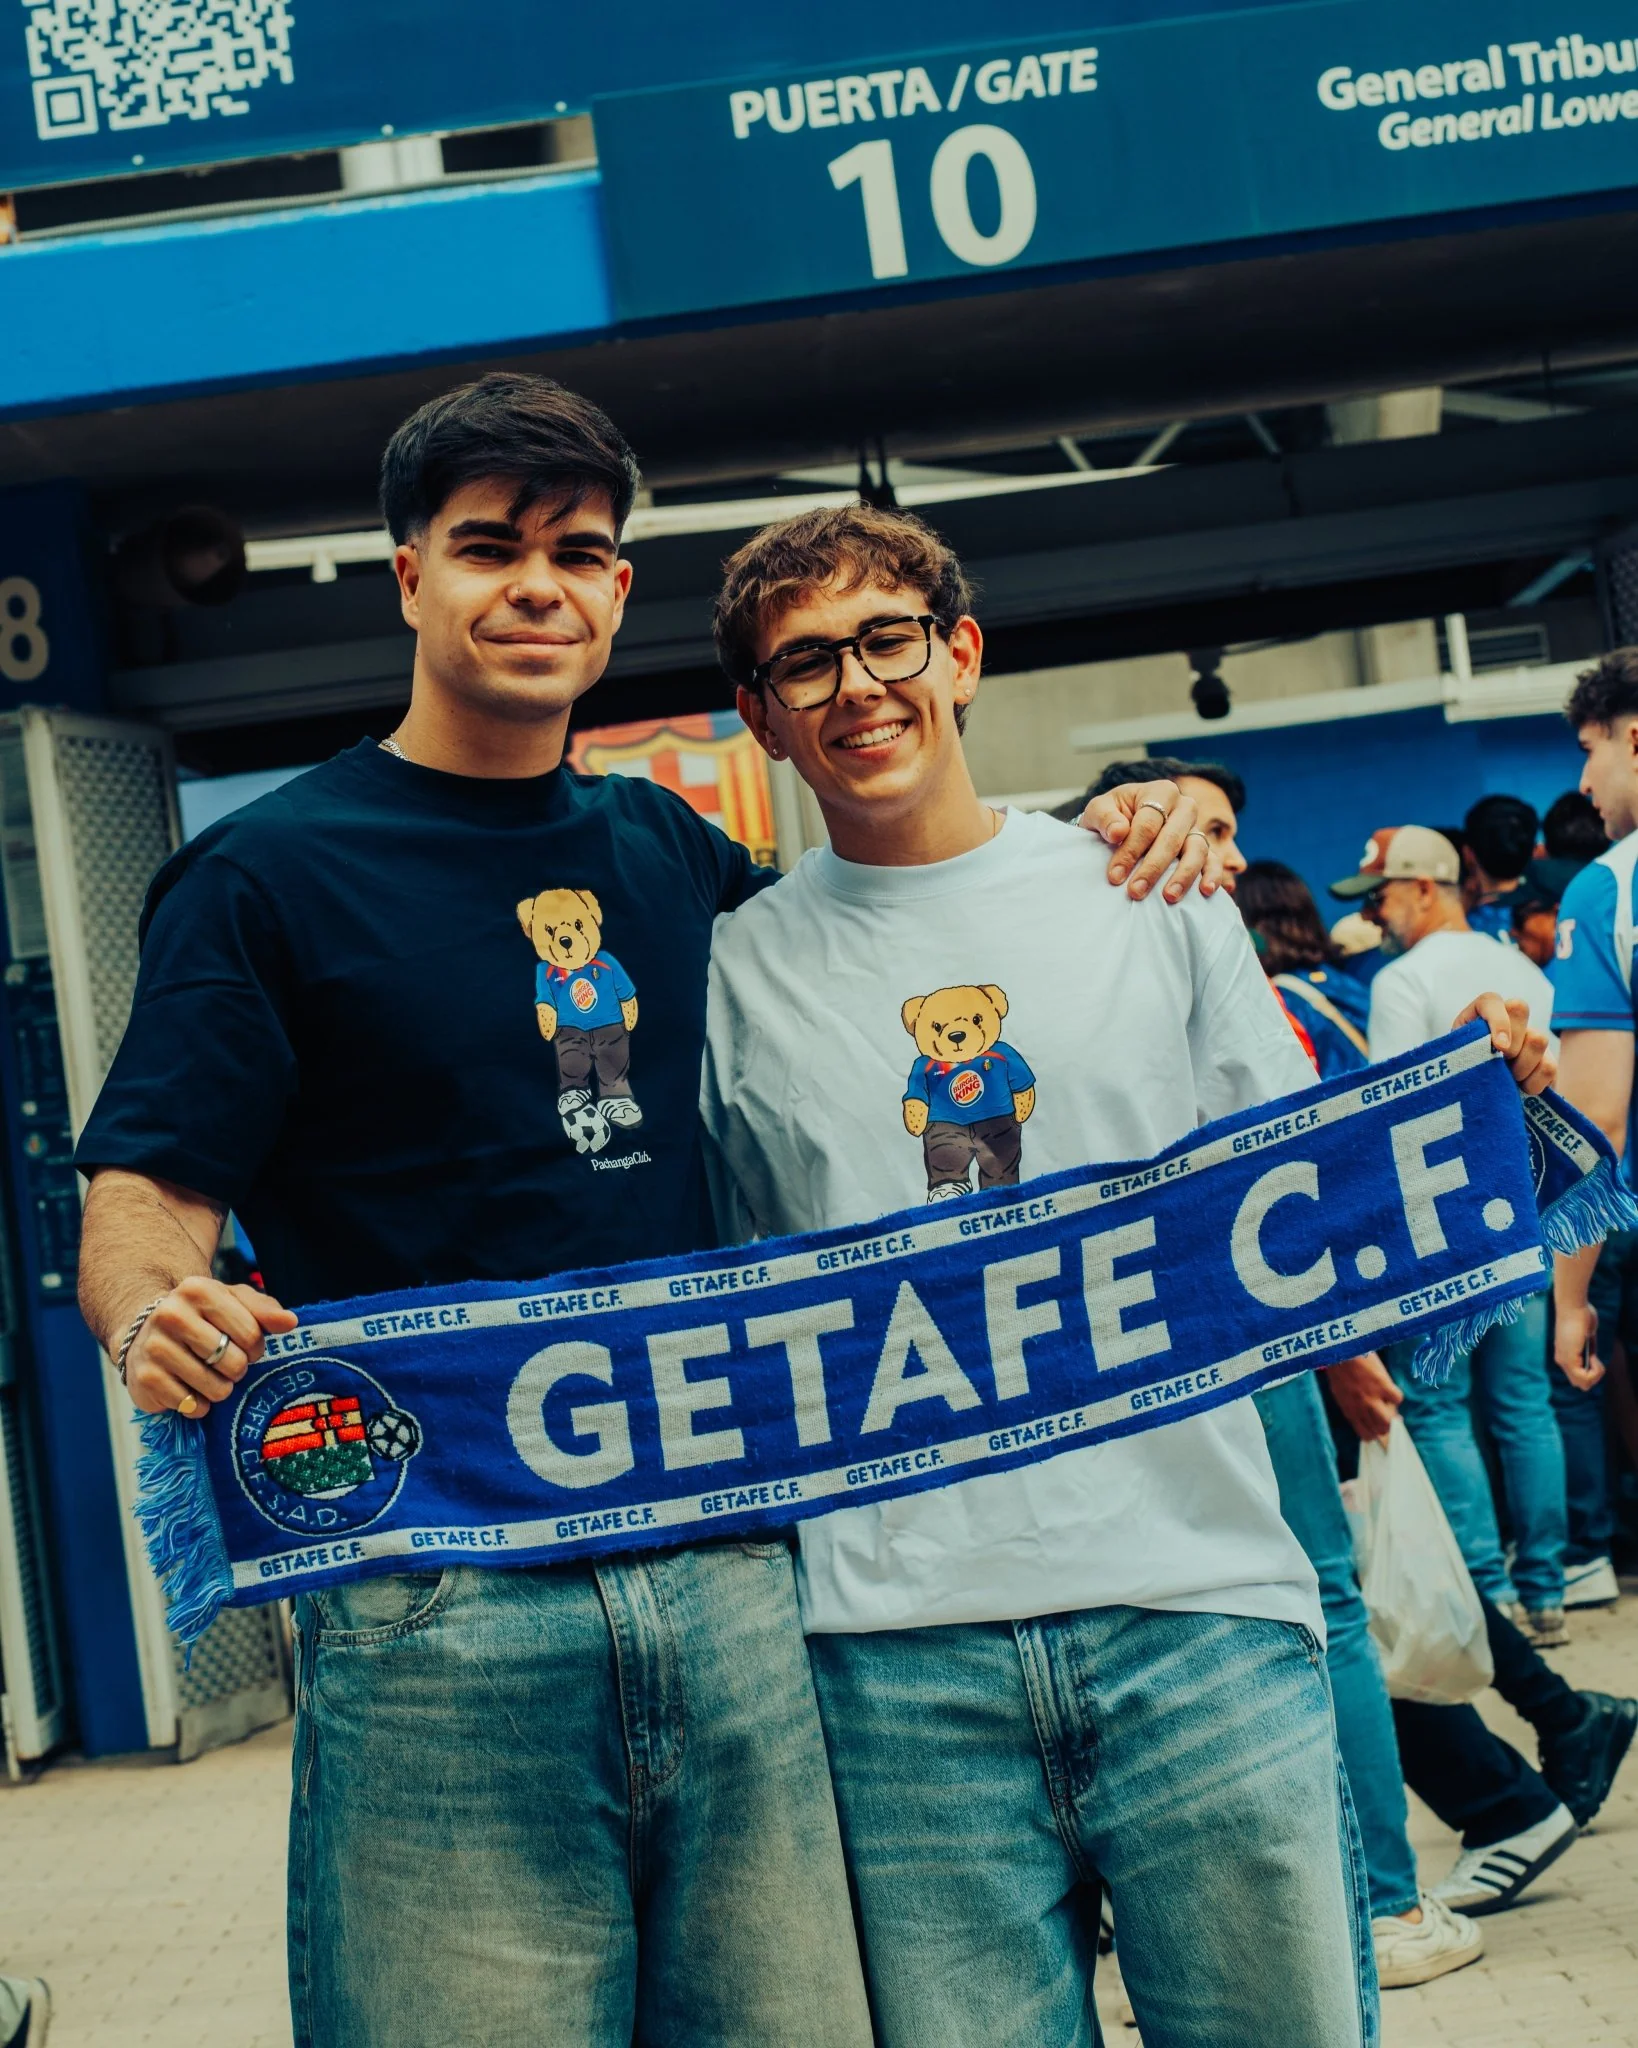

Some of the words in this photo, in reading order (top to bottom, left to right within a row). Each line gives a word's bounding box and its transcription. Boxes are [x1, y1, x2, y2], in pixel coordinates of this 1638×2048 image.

[1317, 44, 1506, 111] General
[1507, 33, 1638, 85] Tribu
[729, 66, 941, 139] PUERTA
[1378, 93, 1534, 151] General
[827, 123, 1037, 280] 10
[0, 576, 49, 681] 8
[576, 987, 595, 1006] KING
[953, 1074, 978, 1092] BURGER
[955, 1080, 981, 1102] KING
[1361, 1071, 1422, 1105] GETAFE
[1425, 1060, 1450, 1082] C.F.
[1233, 1120, 1292, 1153] GETAFE
[1295, 1110, 1321, 1131] C.F.
[1524, 1096, 1568, 1142] GETAFE
[1562, 1136, 1583, 1154] C.F.
[1100, 1167, 1161, 1199] GETAFE
[1164, 1158, 1191, 1179] C.F.
[959, 1207, 1026, 1236] GETAFE
[1029, 1199, 1057, 1220] C.F.
[816, 1241, 883, 1270] GETAFE
[886, 1234, 916, 1254] C.F.
[504, 1216, 1172, 1490] GETAFE
[1230, 1101, 1515, 1309] C.F.
[669, 1271, 738, 1298] GETAFE
[742, 1266, 771, 1286] C.F.
[1399, 1280, 1466, 1316] GETAFE
[1469, 1268, 1498, 1291] C.F.
[362, 1311, 436, 1337] GETAFE
[439, 1308, 471, 1328] C.F.
[518, 1294, 588, 1319] GETAFE
[592, 1289, 623, 1309] C.F.
[282, 1330, 317, 1351] C.F.
[1262, 1331, 1325, 1363] GETAFE
[1329, 1320, 1358, 1343] C.F.
[1130, 1377, 1192, 1411] GETAFE
[1196, 1368, 1223, 1390] C.F.
[988, 1421, 1055, 1451] GETAFE
[1058, 1412, 1086, 1433] C.F.
[846, 1456, 910, 1485] GETAFE
[914, 1450, 944, 1469] C.F.
[700, 1487, 769, 1514] GETAFE
[773, 1482, 802, 1502] C.F.
[411, 1531, 478, 1548] GETAFE
[481, 1529, 509, 1545] C.F.
[556, 1512, 623, 1539] GETAFE
[627, 1507, 657, 1526] C.F.
[259, 1550, 328, 1578] GETAFE
[332, 1541, 365, 1562] C.F.
